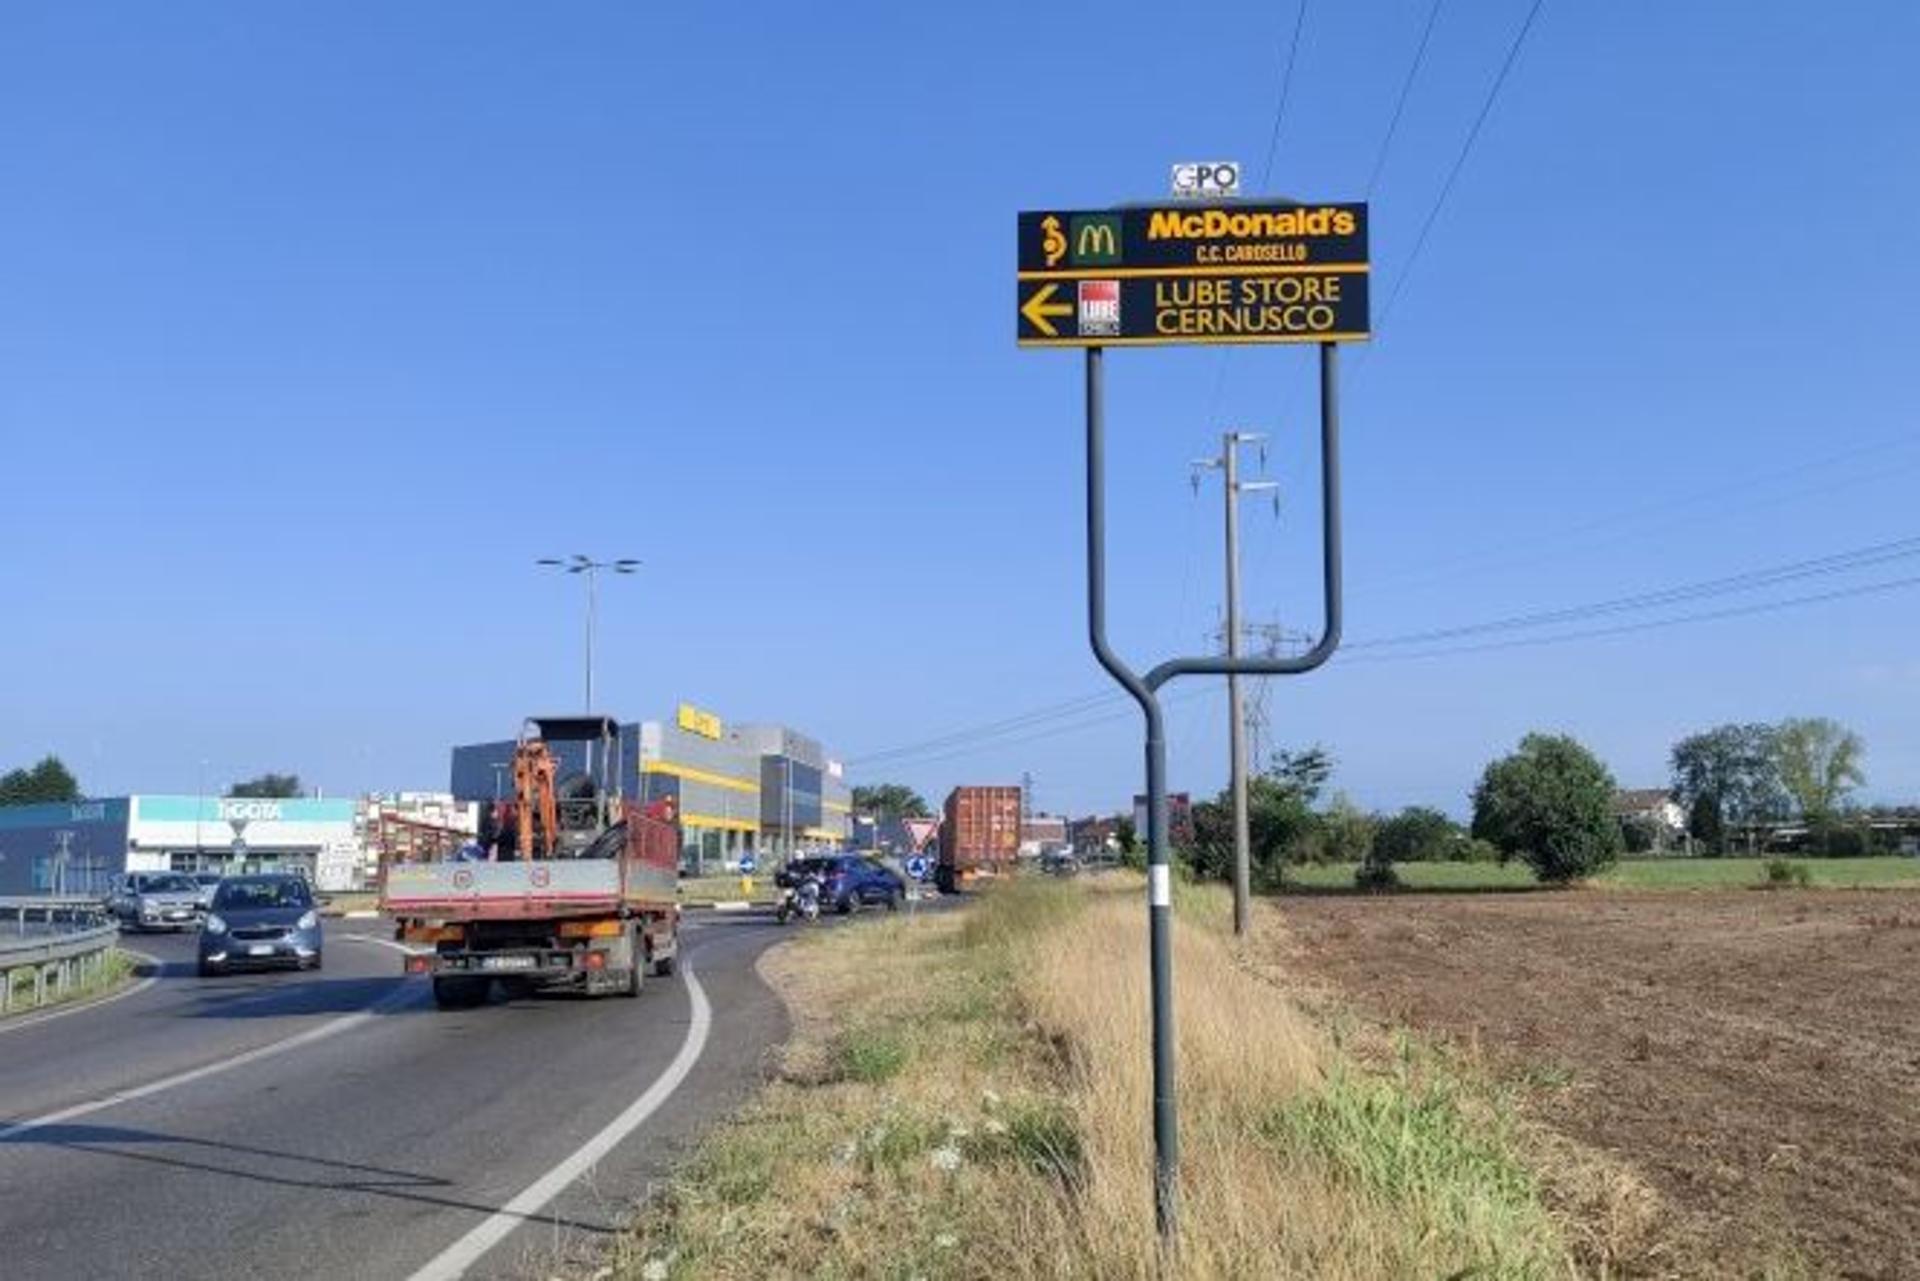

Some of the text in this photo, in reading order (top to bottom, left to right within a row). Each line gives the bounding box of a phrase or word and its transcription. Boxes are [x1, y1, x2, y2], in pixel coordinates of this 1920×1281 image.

[1174, 165, 1236, 189] GPO
[1148, 208, 1355, 240] McDonald's
[1155, 277, 1342, 307] LUBE STORE
[1155, 305, 1335, 333] CERNUSCO
